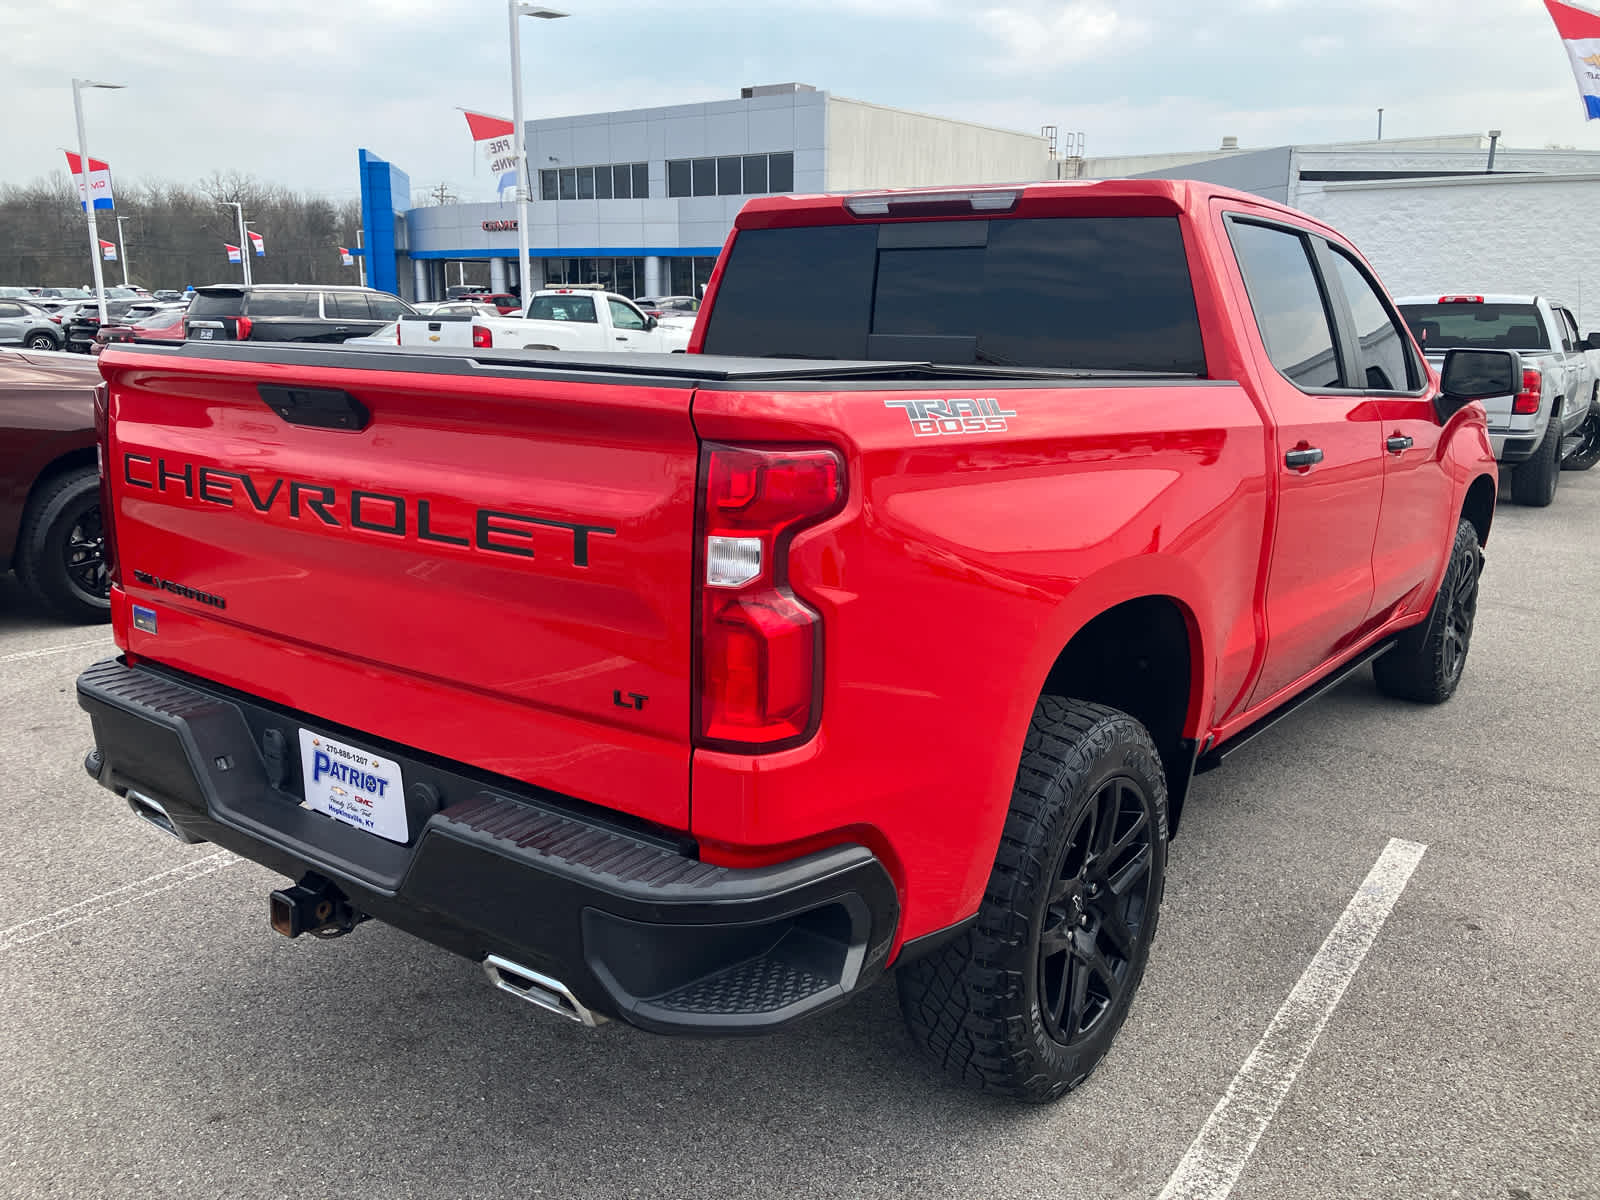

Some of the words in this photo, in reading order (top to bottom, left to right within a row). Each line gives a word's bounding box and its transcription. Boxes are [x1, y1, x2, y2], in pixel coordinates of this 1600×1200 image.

[482, 219, 519, 232] GMC
[884, 398, 1016, 419] TRAIL
[910, 416, 1008, 437] BOSS
[123, 452, 617, 569] CHEVROLET
[613, 689, 649, 711] LT
[314, 750, 388, 796] PATRIOT
[355, 795, 373, 808] GMC
[365, 819, 374, 828] KY
